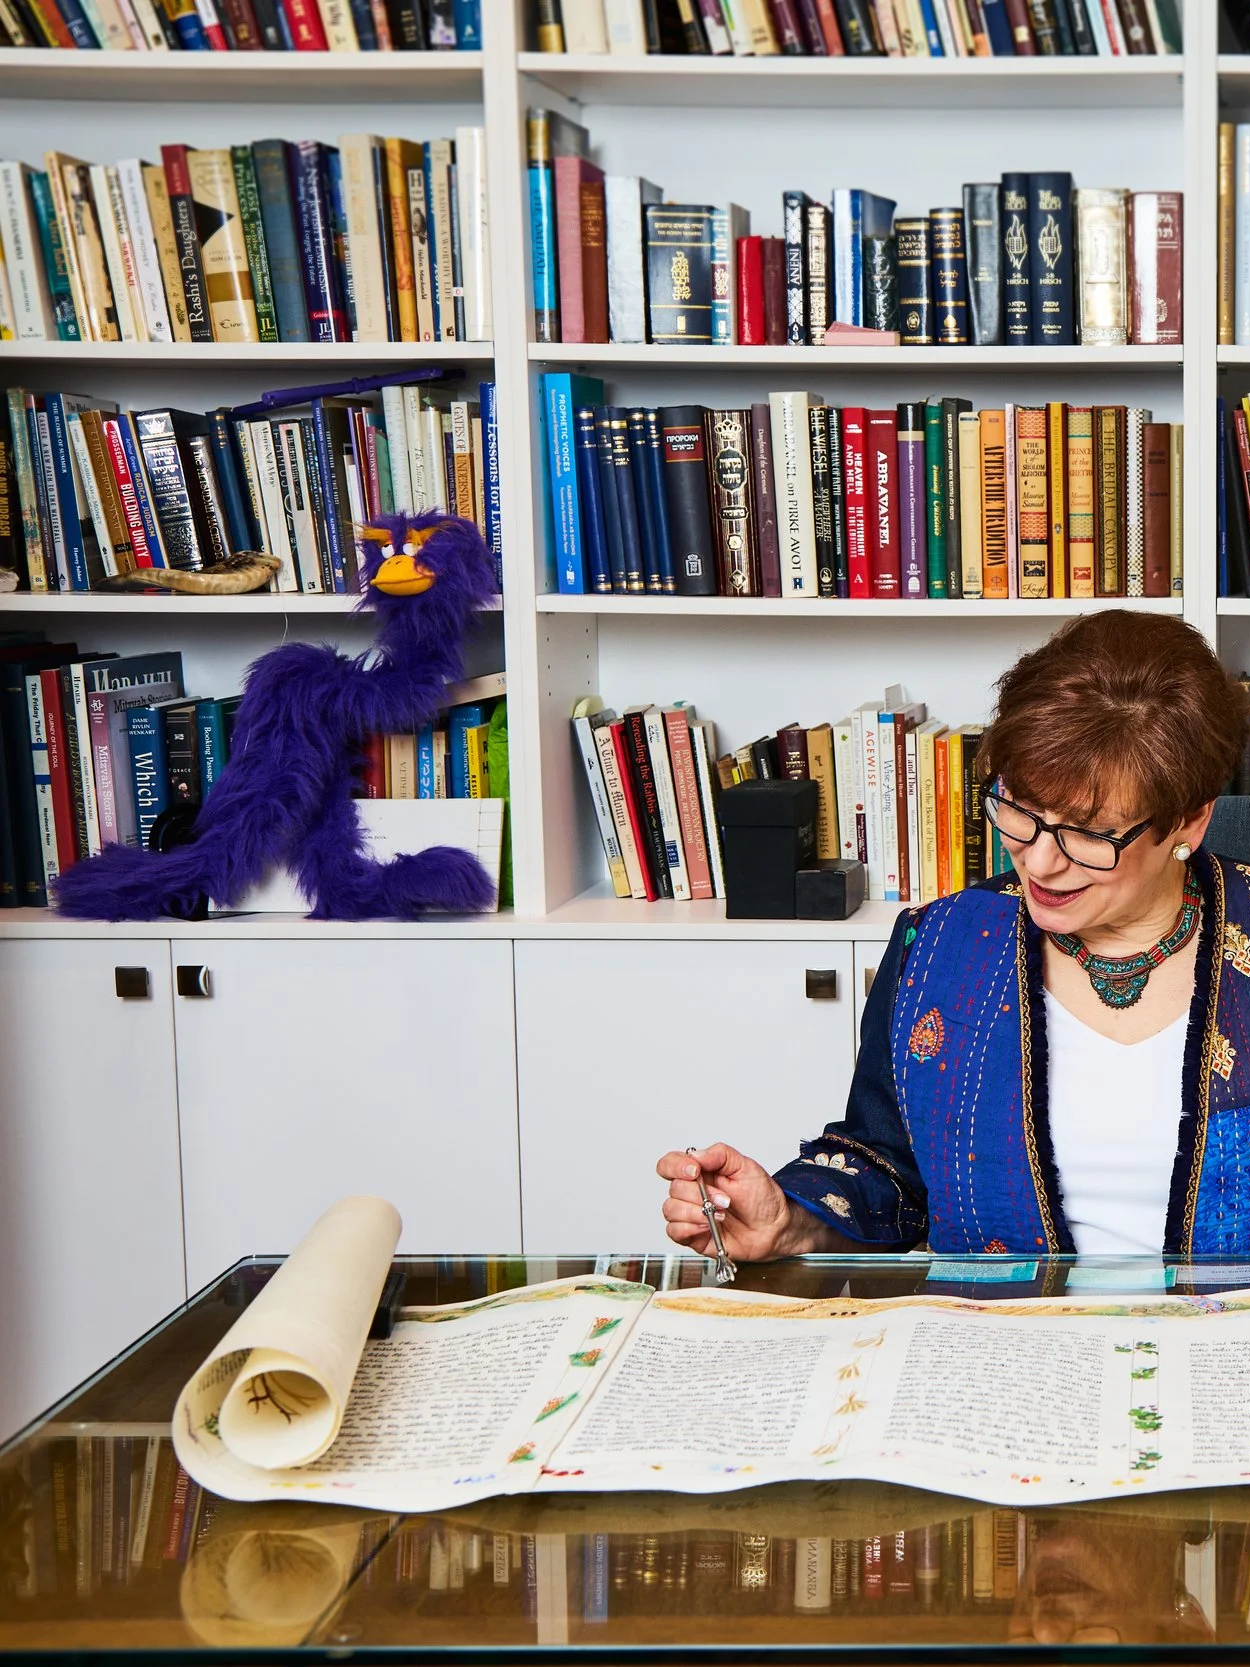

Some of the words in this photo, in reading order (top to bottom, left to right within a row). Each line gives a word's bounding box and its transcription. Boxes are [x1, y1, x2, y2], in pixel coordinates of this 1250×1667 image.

[175, 201, 196, 269] Daughters
[789, 248, 800, 284] ANENI
[185, 274, 204, 323] Rashi's
[454, 406, 465, 437] GATES
[559, 394, 569, 440] PROPHETIC
[811, 410, 825, 432] ELIE
[456, 439, 466, 452] OF
[487, 423, 500, 482] Lessons
[561, 442, 570, 472] VOICES
[813, 434, 828, 475] WIESEL
[1104, 430, 1115, 454] THE
[58, 448, 67, 473] SUMMER
[854, 454, 863, 494] HEAVEN
[984, 444, 1005, 481] AFTER
[109, 431, 126, 474] PROSSERMAN
[120, 483, 140, 527] BUILDING
[132, 530, 148, 557] UNITY
[126, 438, 134, 455] Arthur
[130, 455, 138, 472] Green
[135, 473, 147, 503] RADICAL
[142, 506, 155, 537] JUDAISM
[490, 486, 501, 505] for
[787, 483, 796, 496] on
[846, 469, 854, 494] HELL
[985, 482, 1005, 502] THE
[1104, 462, 1116, 510] BRIDAL
[193, 450, 206, 465] The
[207, 516, 223, 559] MACHZOR
[877, 451, 889, 548] ABRAVANEL
[491, 510, 501, 553] Living
[788, 500, 800, 534] PIRKE
[985, 507, 1006, 567] TRADITION
[1105, 520, 1117, 574] CANOPY
[791, 537, 802, 571] AVOT
[31, 682, 39, 696] The
[31, 698, 40, 719] Friday
[204, 726, 212, 755] Booking
[599, 737, 611, 746] A
[631, 716, 648, 763] Rereading
[98, 746, 111, 788] Mitzvah
[205, 757, 214, 783] Passage
[601, 749, 617, 776] Time
[641, 765, 650, 780] the
[866, 730, 876, 787] AGEWISE
[135, 752, 159, 807] Which
[608, 778, 617, 789] to
[908, 776, 916, 796] Thou
[925, 779, 932, 790] On
[101, 791, 114, 827] Stories
[610, 791, 627, 827] Mourn
[643, 782, 657, 814] Rabbis
[925, 792, 933, 805] the
[972, 784, 981, 820] Heschel
[925, 807, 934, 825] Book
[926, 827, 935, 835] of
[927, 837, 936, 862] Psalms
